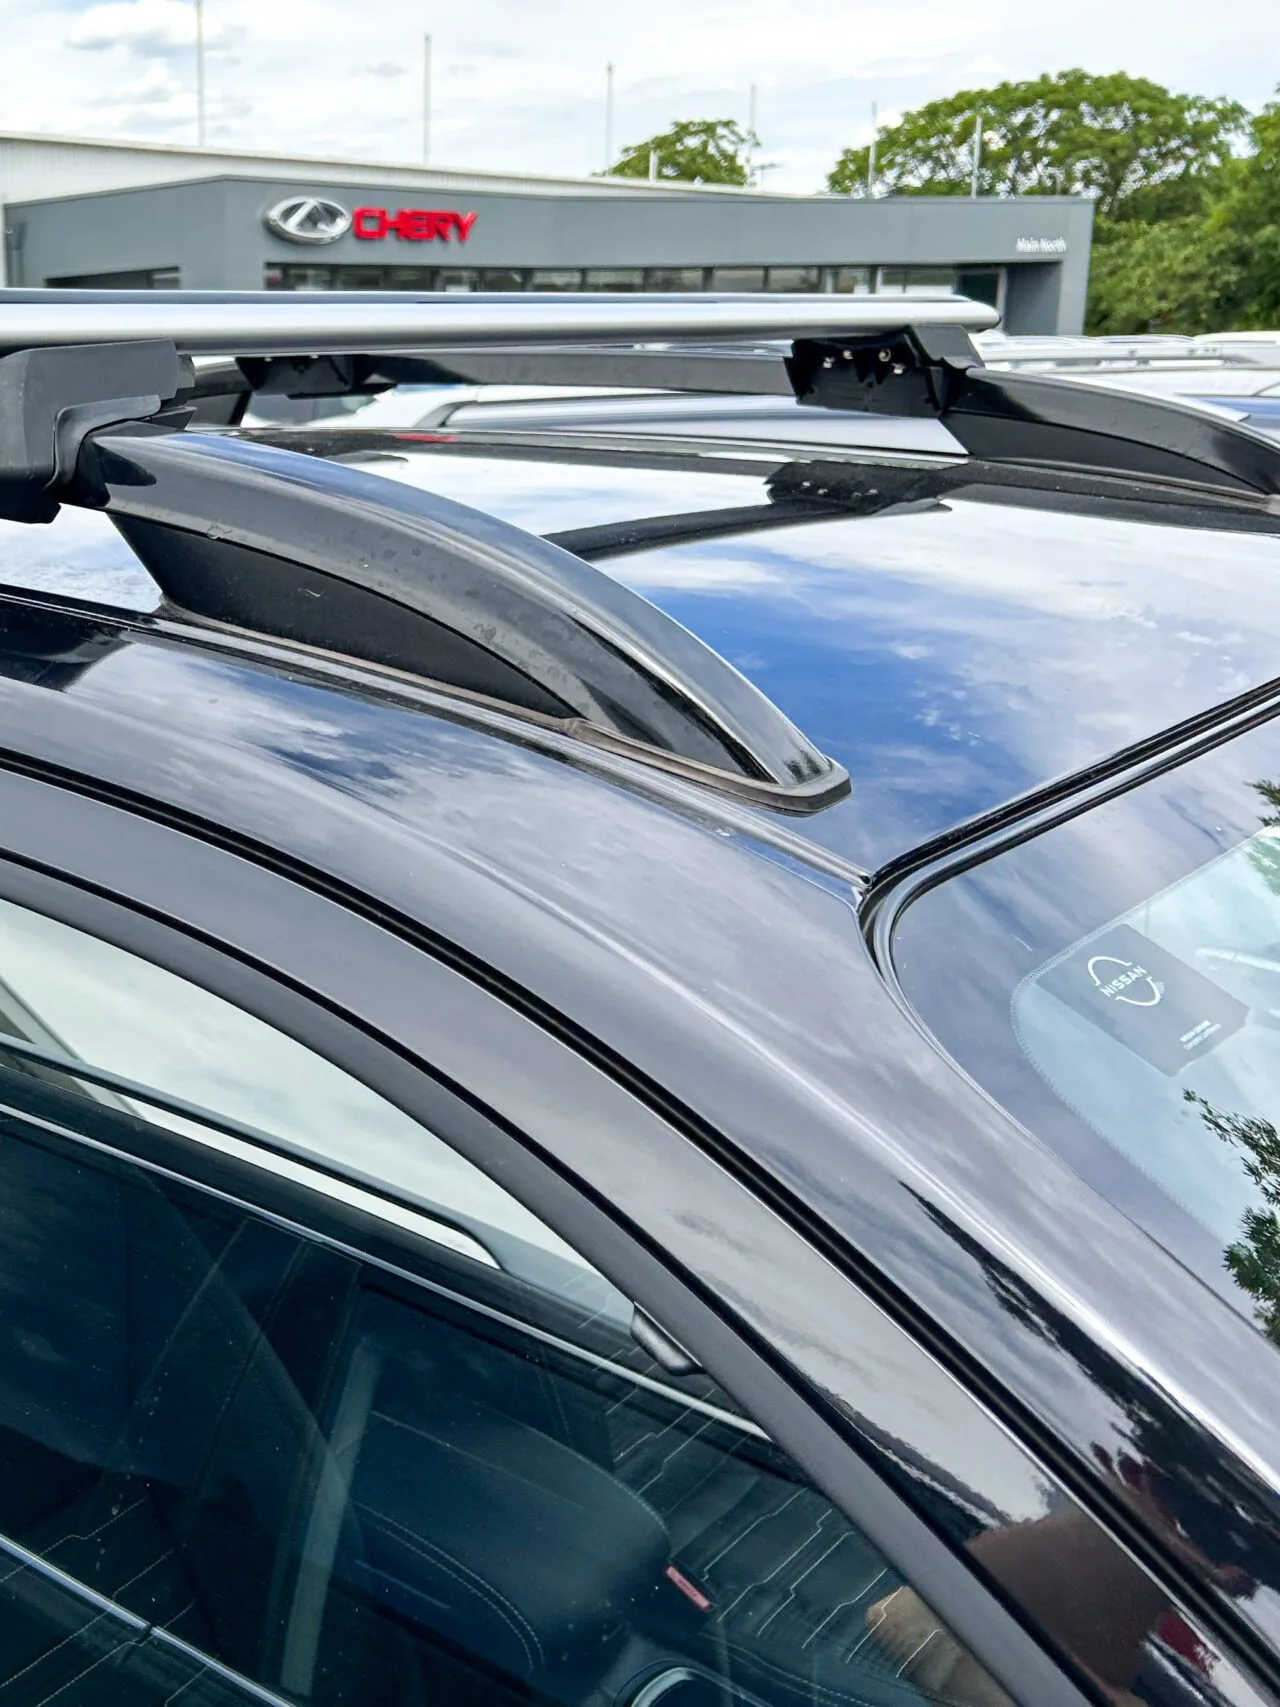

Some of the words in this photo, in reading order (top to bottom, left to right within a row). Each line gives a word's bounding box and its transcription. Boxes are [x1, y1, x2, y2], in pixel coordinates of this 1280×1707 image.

[354, 208, 476, 240] CHERY
[1016, 236, 1040, 252] Main
[1040, 236, 1067, 252] North
[1099, 965, 1148, 997] NISSAN
